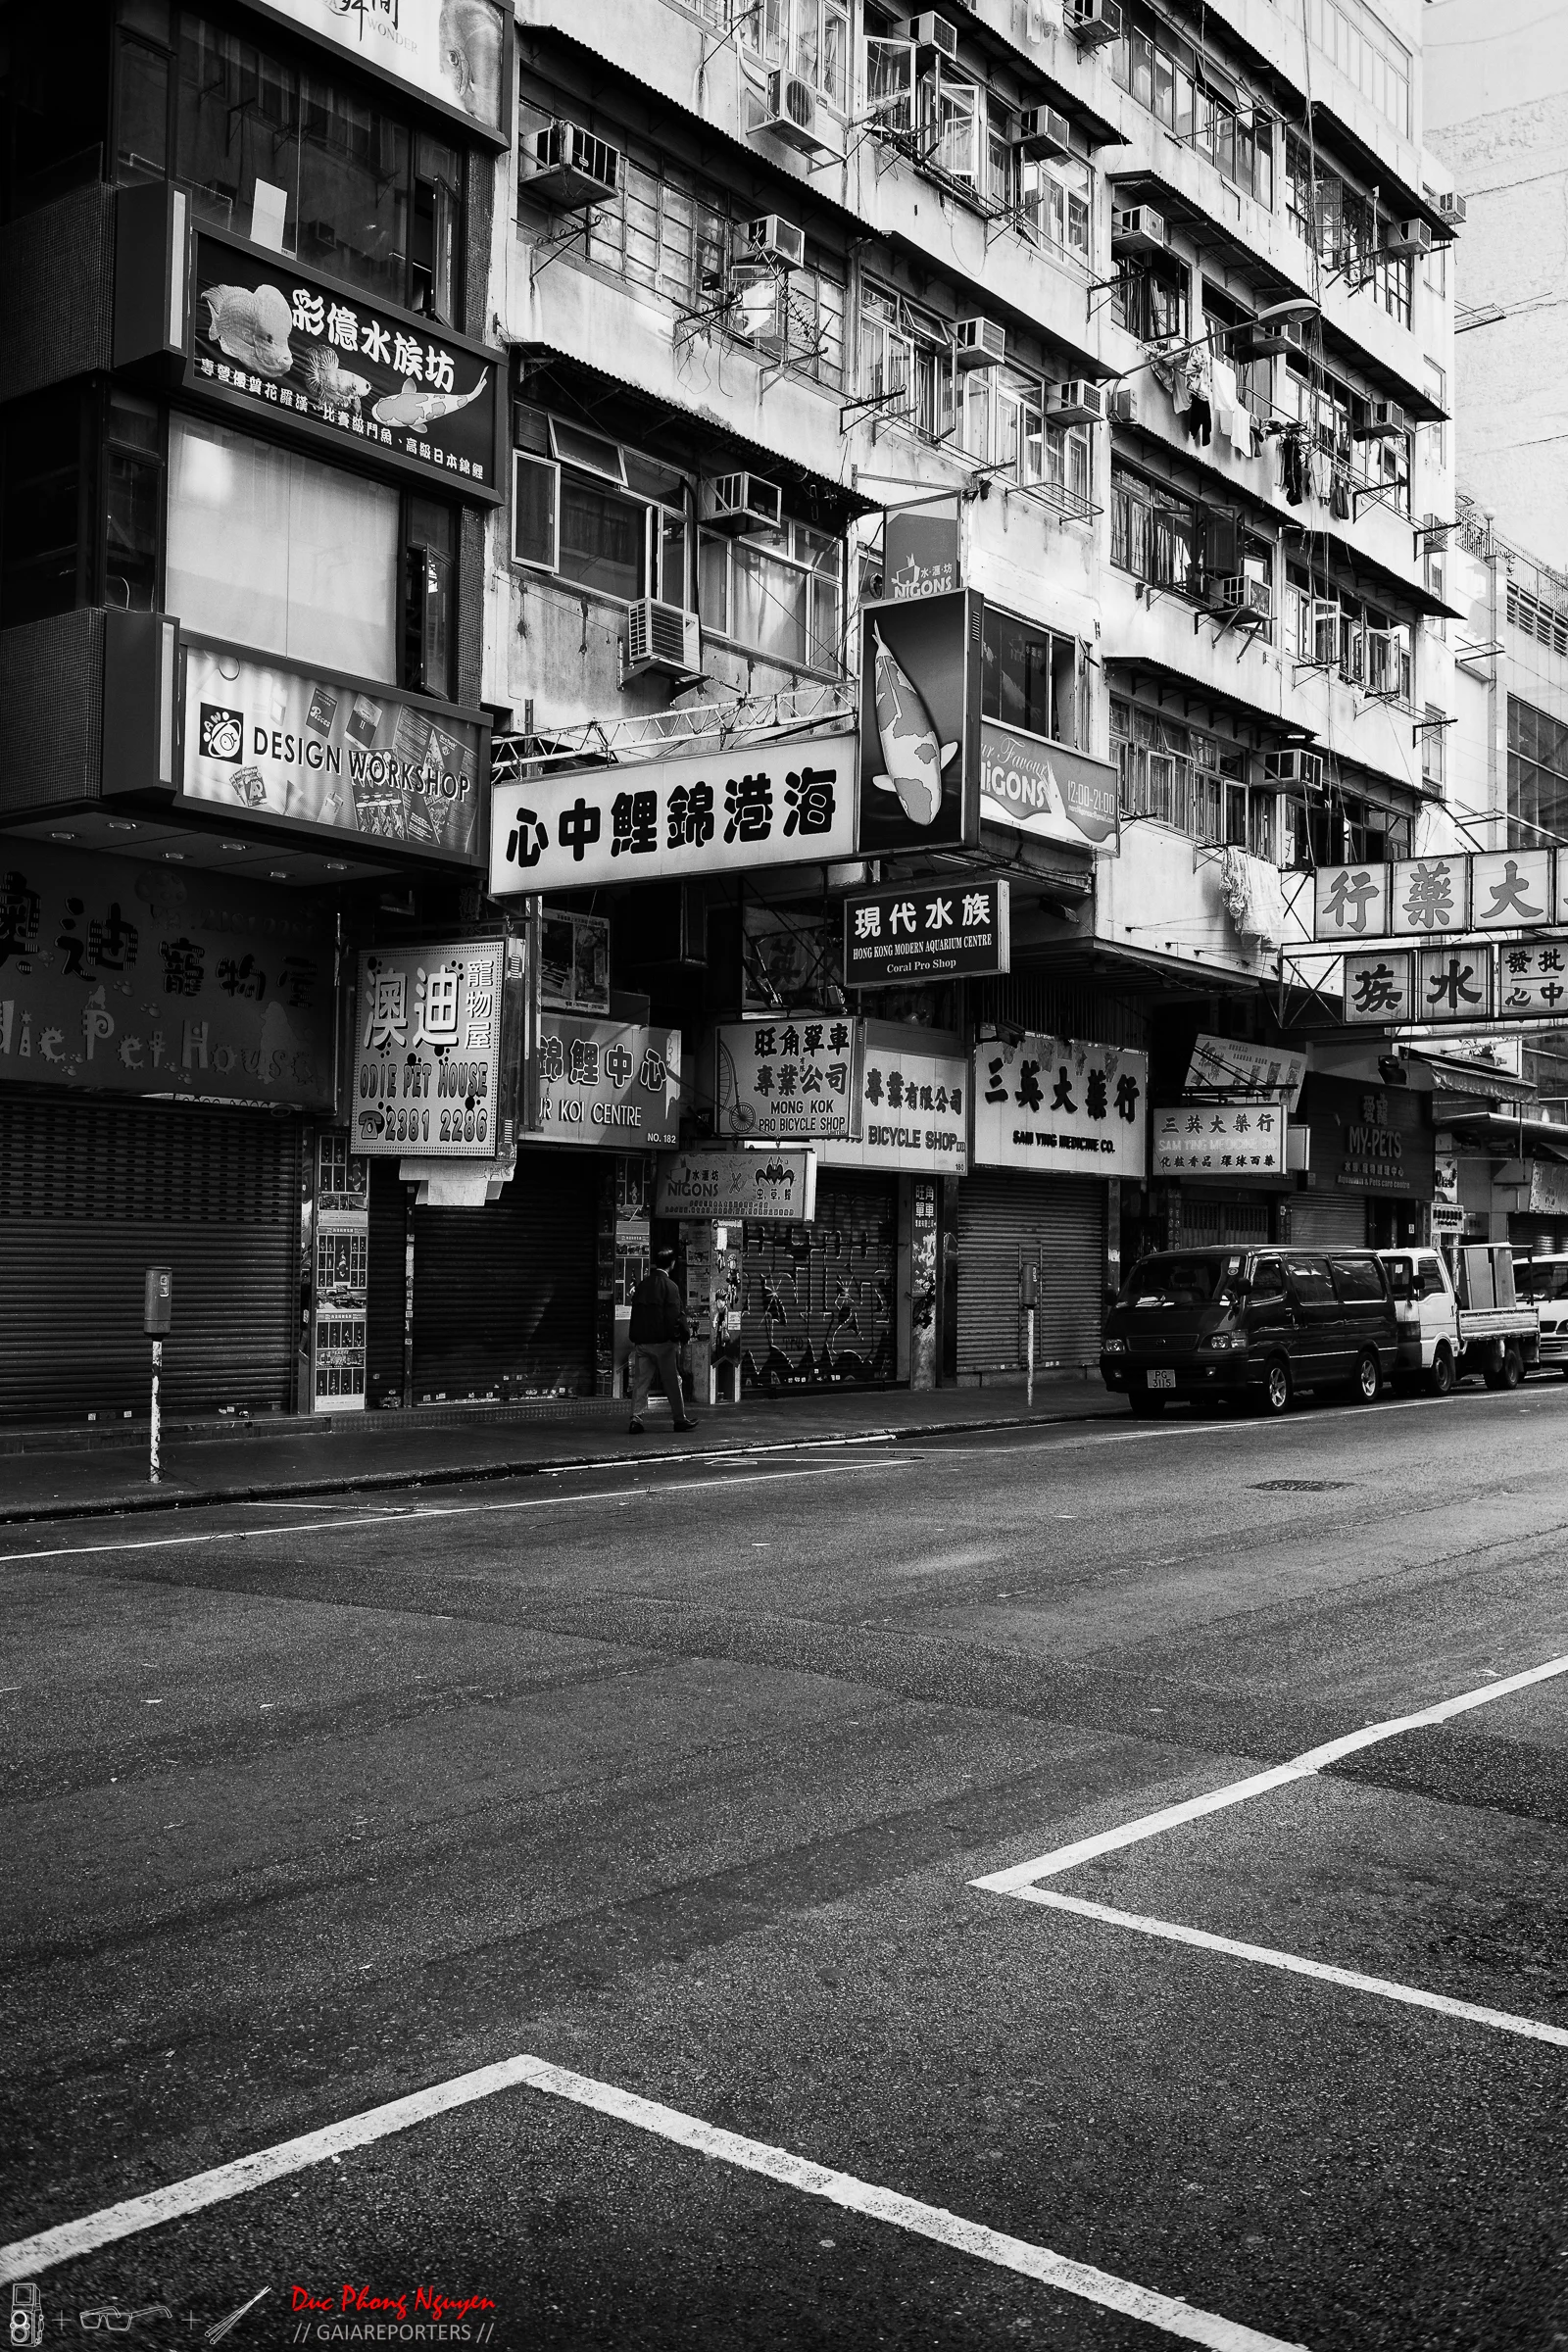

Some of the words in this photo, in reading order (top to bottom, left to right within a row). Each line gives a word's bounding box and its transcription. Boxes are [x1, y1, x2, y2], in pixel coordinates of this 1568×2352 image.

[368, 16, 418, 55] WONDER
[292, 289, 455, 392] 彩億水族坊
[254, 726, 342, 774] DESIGN
[349, 749, 469, 802] WORKSHOP
[855, 893, 991, 939] 現代水族
[853, 948, 872, 959] HONG
[874, 946, 893, 958] KONG
[895, 941, 924, 956] MODERN
[925, 937, 962, 954] AQUARIUM
[963, 933, 992, 948] CENTRE
[887, 961, 911, 973] Coral
[914, 960, 930, 970] Pro
[932, 958, 956, 969] Shop
[364, 965, 459, 1049] 澳迪
[465, 959, 494, 1050] 寵物屋
[754, 1023, 850, 1057] 旺角單車
[360, 1063, 397, 1099] ODIE
[403, 1063, 431, 1099] PET
[438, 1061, 488, 1099] HOUSE
[864, 1068, 962, 1115] 專業有限公司
[985, 1057, 1140, 1124] 三英大藥行
[561, 1100, 585, 1121] KOI
[592, 1102, 642, 1127] CENTRE
[770, 1101, 804, 1114] MONG
[810, 1100, 834, 1113] KOK
[385, 1108, 430, 1142] 2381
[440, 1108, 488, 1142] 2286
[760, 1118, 776, 1132] PRO
[780, 1117, 815, 1131] BICYCLE
[820, 1117, 845, 1130] SHOP
[1161, 1113, 1275, 1134] 三英大藥行
[648, 1133, 662, 1143] NO.
[663, 1134, 676, 1144] 182
[868, 1125, 921, 1149] BICYCLE
[925, 1131, 956, 1152] SHOP
[1013, 1130, 1033, 1145] SAM
[1035, 1133, 1057, 1148] YING
[1058, 1135, 1100, 1152] MEDICINE
[1101, 1140, 1115, 1153] CO.
[1158, 1140, 1182, 1152] SAM
[1184, 1139, 1206, 1151] YING
[1209, 1138, 1258, 1151] MEDICINE
[915, 1185, 934, 1200] 旺角
[915, 1201, 934, 1218] 單車
[1152, 1379, 1171, 1388] 3115
